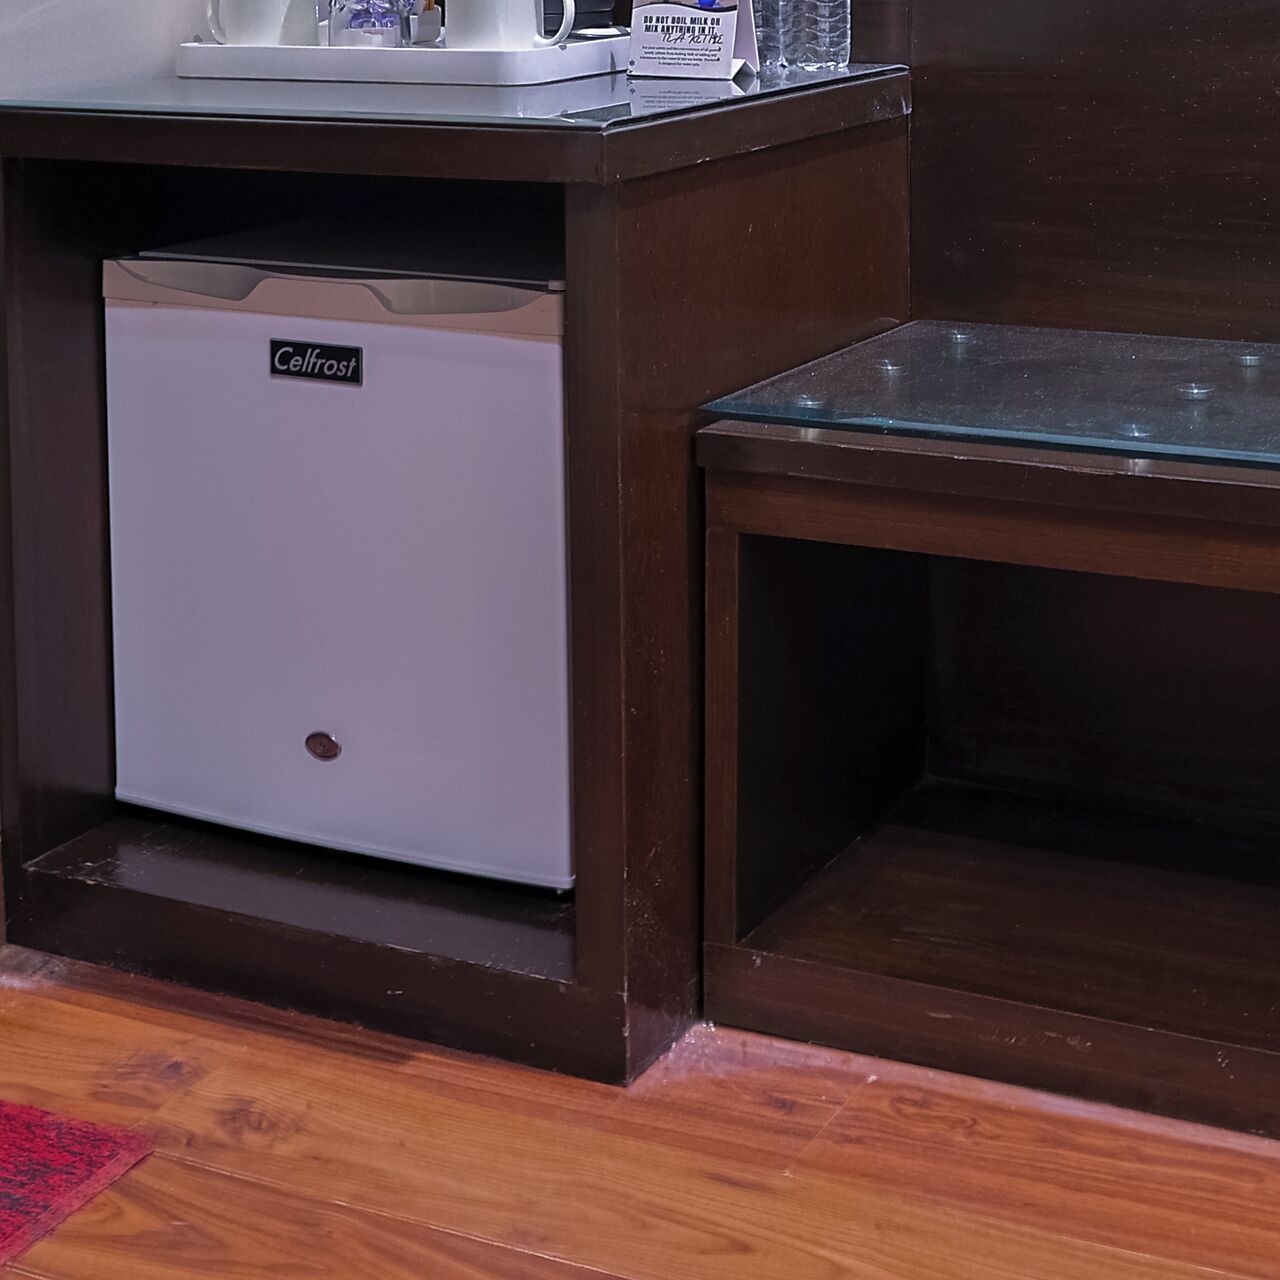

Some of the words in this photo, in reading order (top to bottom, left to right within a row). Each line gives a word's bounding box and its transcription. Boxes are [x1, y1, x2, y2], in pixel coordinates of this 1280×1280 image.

[643, 16, 653, 24] DO
[655, 16, 669, 25] NOT
[671, 16, 687, 25] BOIL
[690, 17, 708, 26] MILK
[710, 17, 721, 26] OR
[644, 24, 658, 33] MIX
[661, 25, 696, 34] ANYTHING
[698, 26, 706, 34] IN
[274, 346, 357, 377] Celfrost
